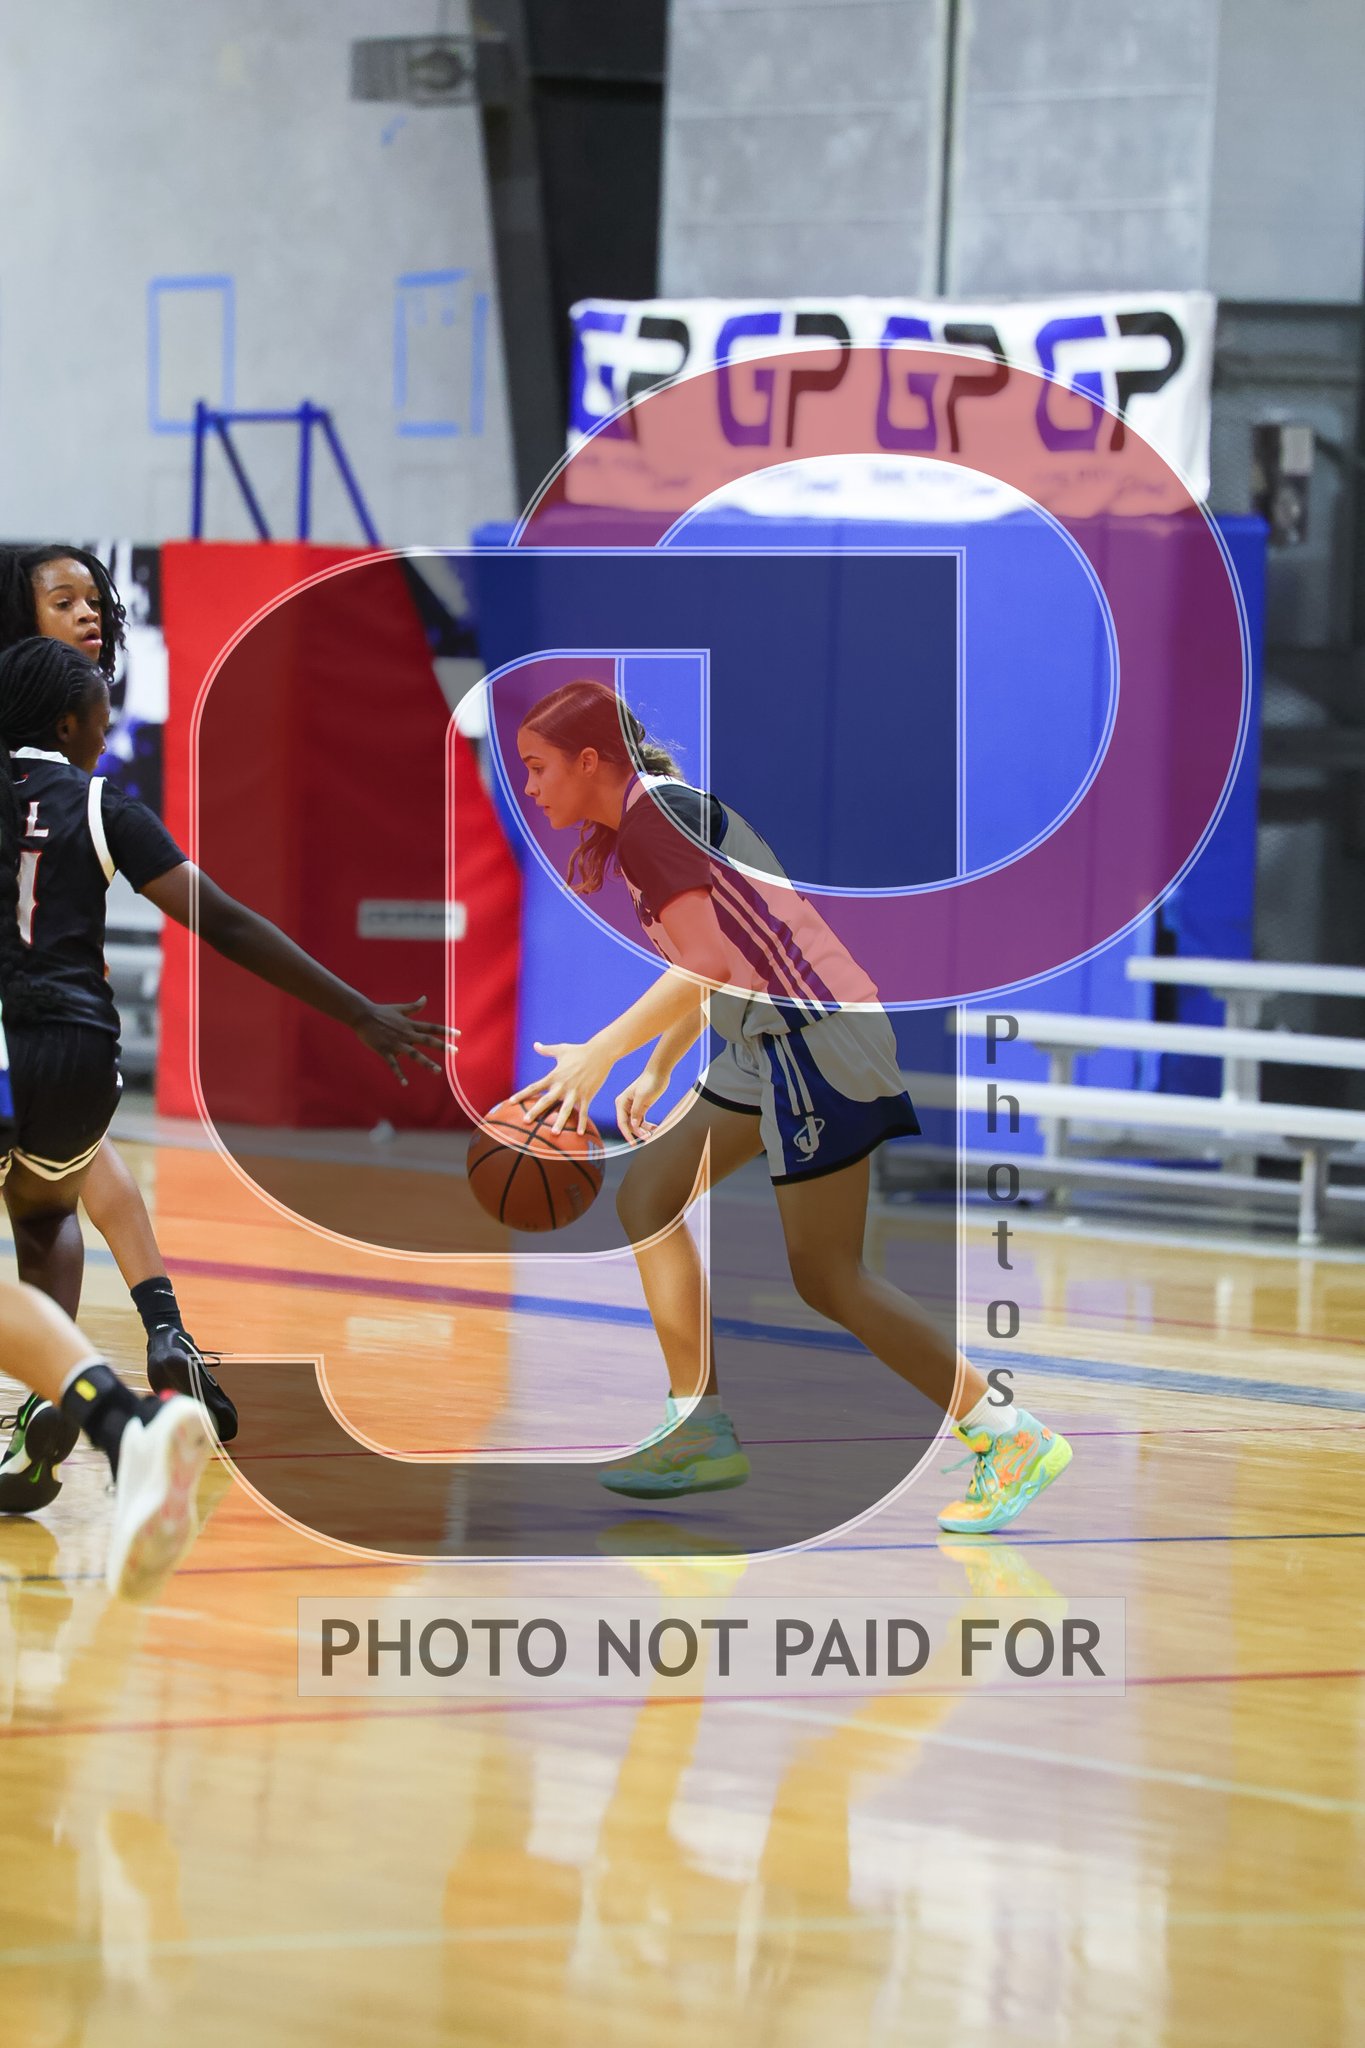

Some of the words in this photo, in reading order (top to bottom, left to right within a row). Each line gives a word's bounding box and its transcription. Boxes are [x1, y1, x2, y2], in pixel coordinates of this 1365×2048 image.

[715, 311, 851, 449] GP
[875, 315, 1010, 453] GP
[1035, 310, 1185, 453] GP
